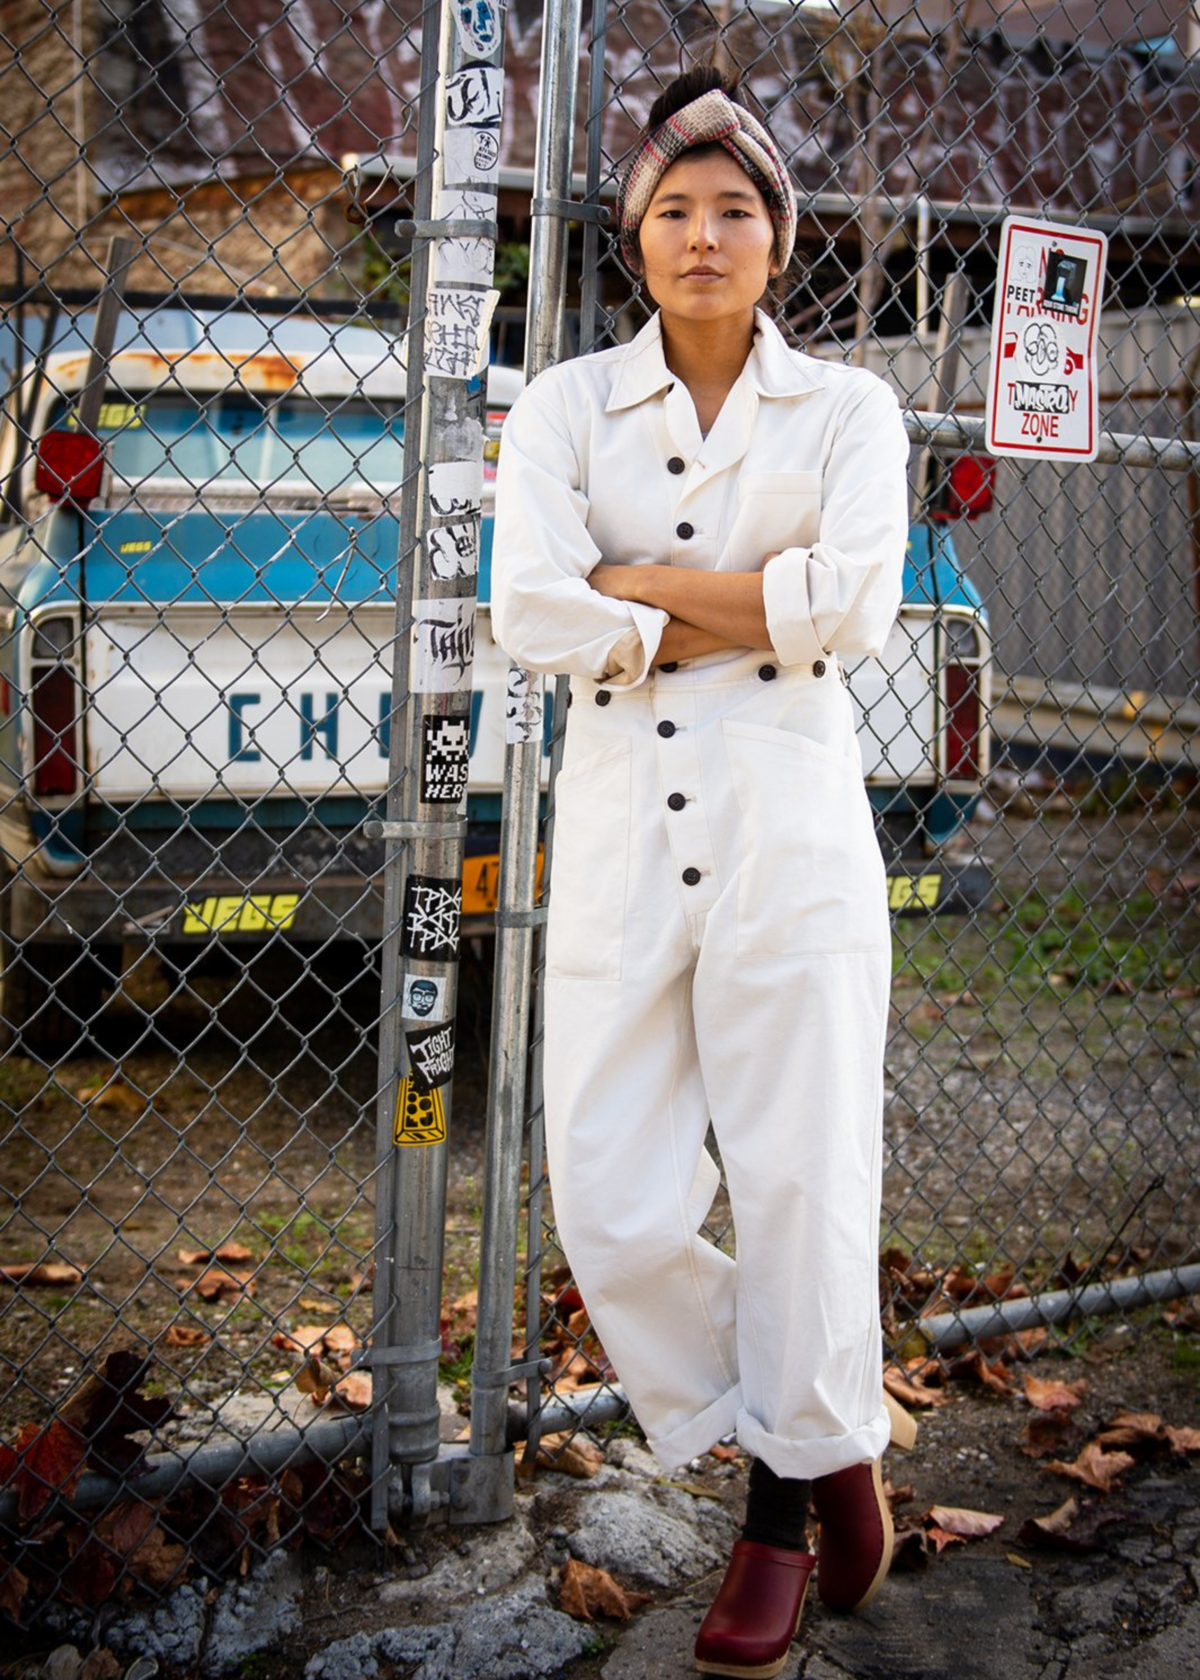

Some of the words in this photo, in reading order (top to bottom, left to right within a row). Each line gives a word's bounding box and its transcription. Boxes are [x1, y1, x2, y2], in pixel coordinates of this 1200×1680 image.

[1007, 284, 1036, 303] PEET
[1021, 412, 1059, 437] ZONE
[426, 764, 469, 782] WAS
[425, 783, 465, 798] HER
[182, 894, 300, 934] JEGS
[410, 1026, 453, 1063] TIGHT
